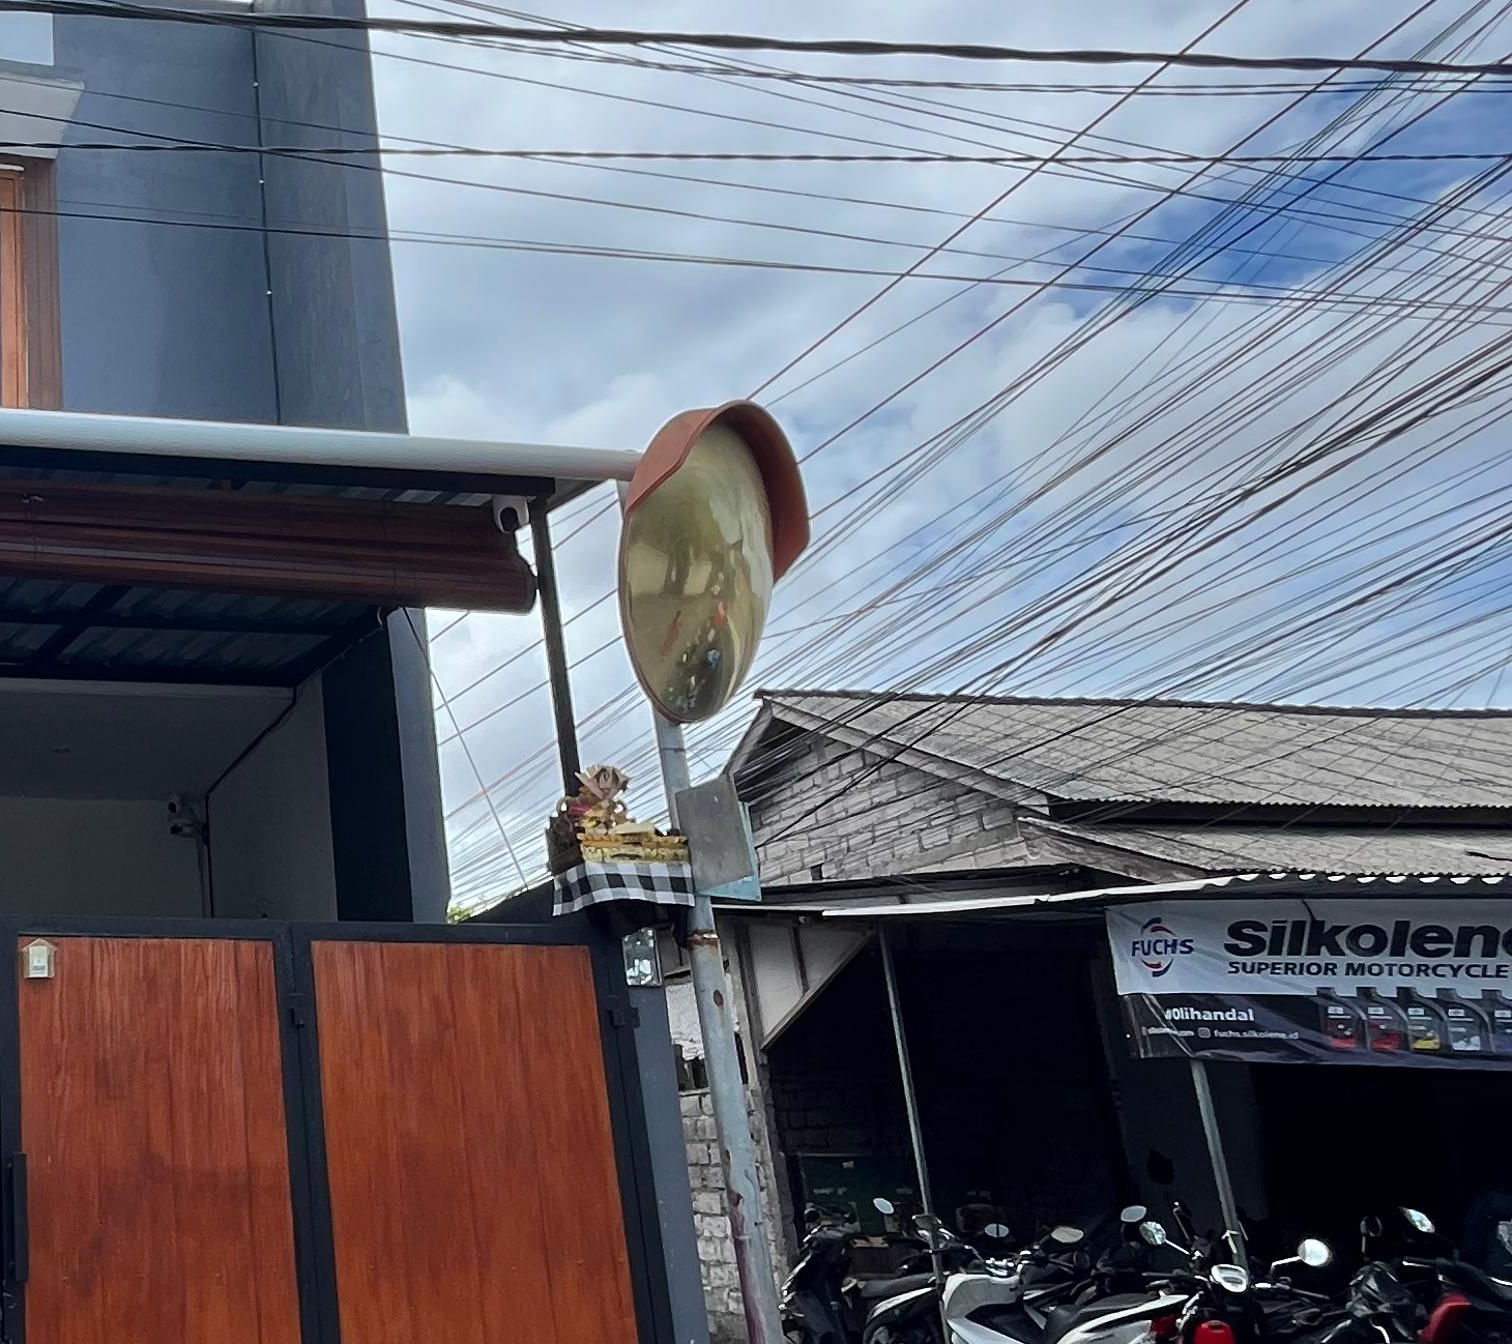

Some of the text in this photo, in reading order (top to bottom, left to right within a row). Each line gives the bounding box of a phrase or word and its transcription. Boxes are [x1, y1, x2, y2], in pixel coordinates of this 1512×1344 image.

[1132, 939, 1194, 957] FUCHS
[1224, 920, 1512, 958] Silkolen
[1227, 961, 1511, 978] SUPERIOR MOTORCYCLE
